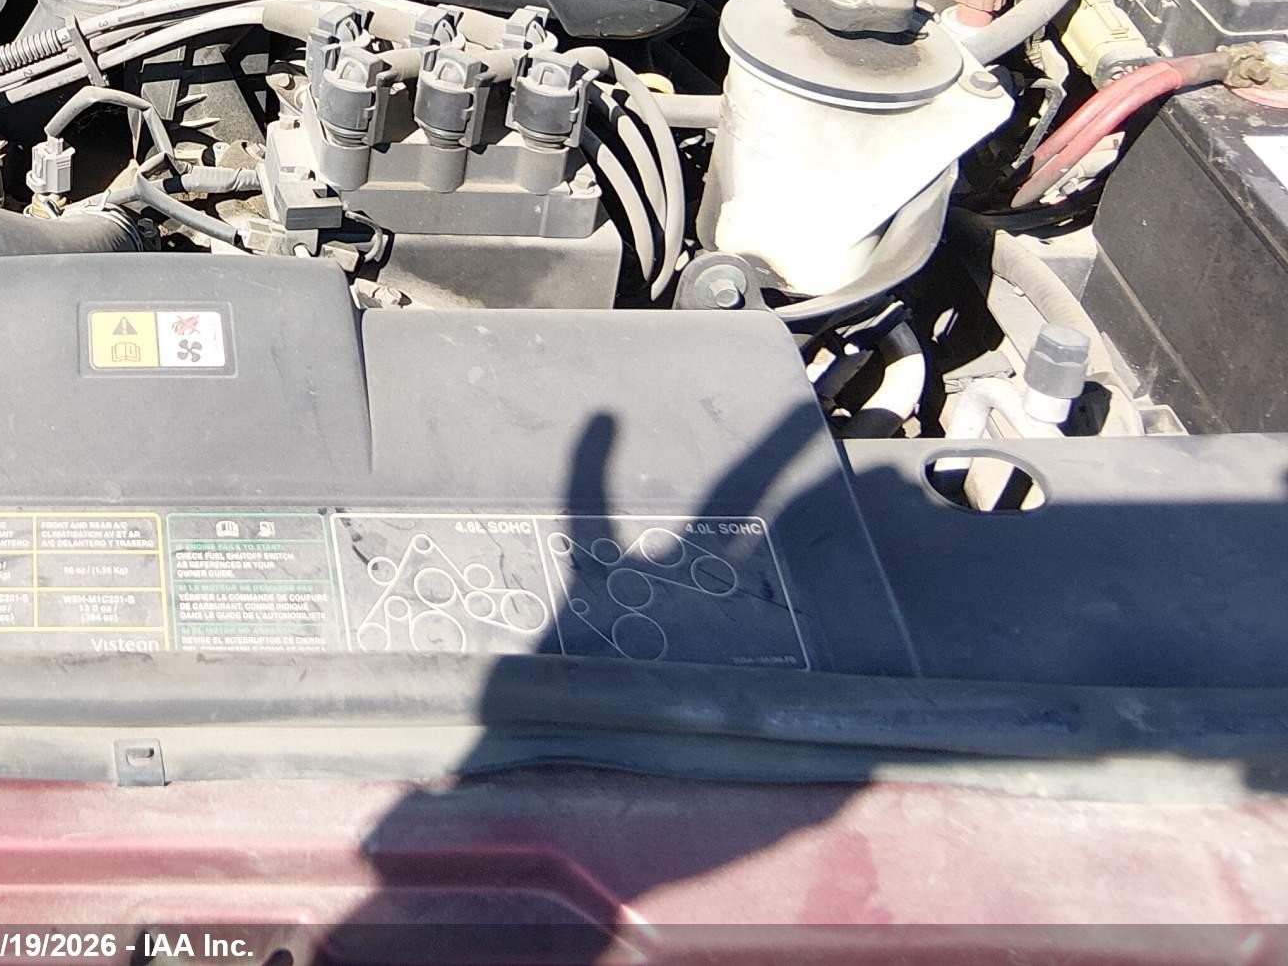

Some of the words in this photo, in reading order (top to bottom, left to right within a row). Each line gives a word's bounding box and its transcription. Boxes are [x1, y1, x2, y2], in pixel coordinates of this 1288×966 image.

[455, 521, 485, 534] 4.6L
[486, 521, 531, 534] SOHC
[684, 522, 715, 536] 4.0L
[719, 522, 762, 536] SOHC
[89, 637, 160, 652] Visteon
